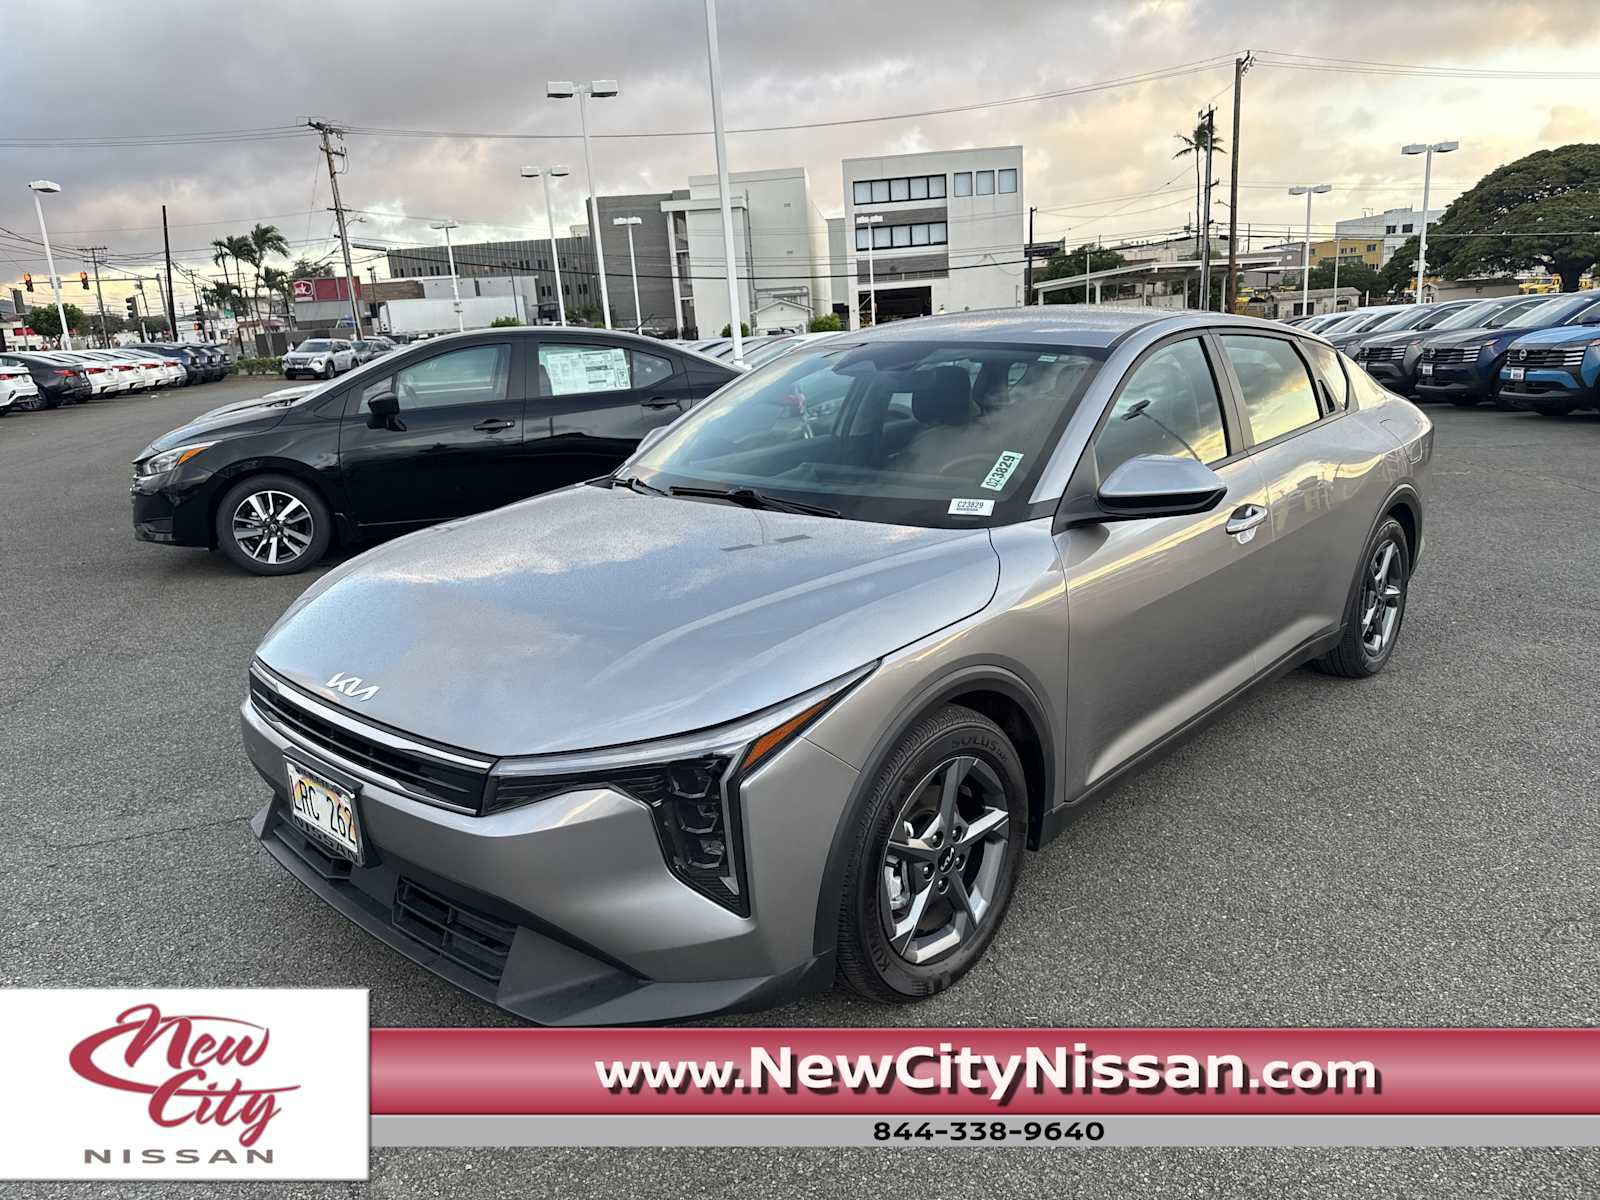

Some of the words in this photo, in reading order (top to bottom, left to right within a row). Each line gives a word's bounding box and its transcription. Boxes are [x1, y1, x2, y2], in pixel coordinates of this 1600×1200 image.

[326, 671, 380, 702] KIA
[289, 775, 320, 821] LRC
[326, 795, 356, 845] 262
